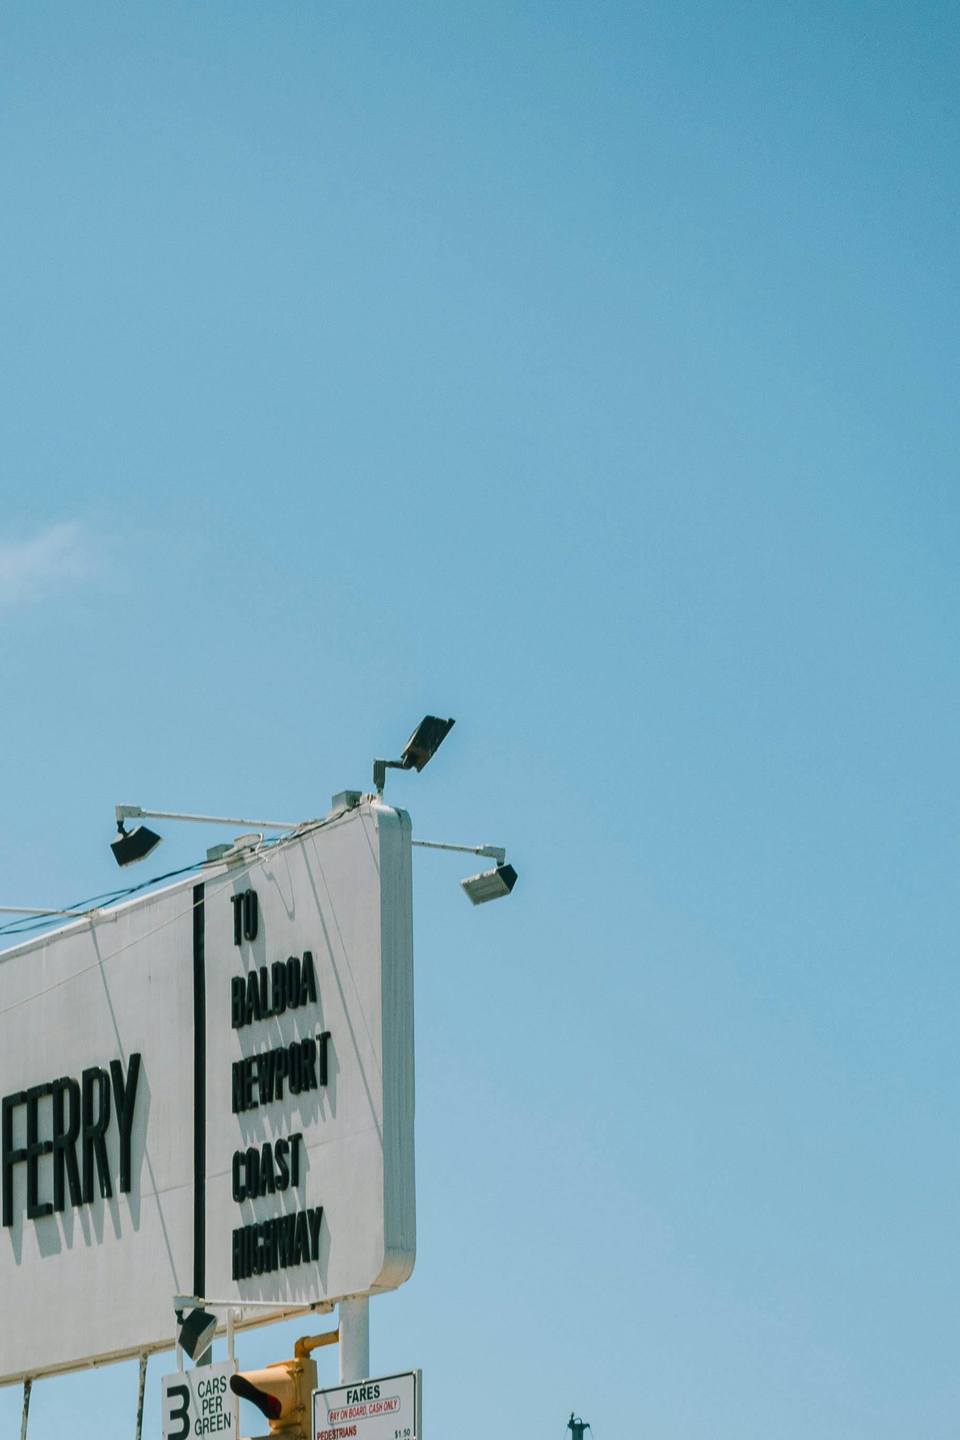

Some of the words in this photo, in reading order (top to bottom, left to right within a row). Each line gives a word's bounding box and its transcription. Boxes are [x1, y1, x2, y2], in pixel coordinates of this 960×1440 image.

[230, 888, 259, 946] TO
[231, 951, 317, 1029] BALBOA
[232, 1031, 331, 1114] NEWPORT
[2, 1053, 141, 1227] FERRY
[232, 1133, 303, 1203] COAST
[232, 1206, 324, 1281] HIGHWAY
[197, 1376, 227, 1398] CARS
[202, 1396, 222, 1416] PER
[346, 1385, 380, 1404] FARES
[194, 1412, 231, 1436] GREEN
[330, 1410, 340, 1422] PAY
[340, 1409, 348, 1420] ON
[369, 1403, 383, 1414] CASH
[383, 1399, 398, 1412] ONLY
[395, 1428, 410, 1439] $1.50
